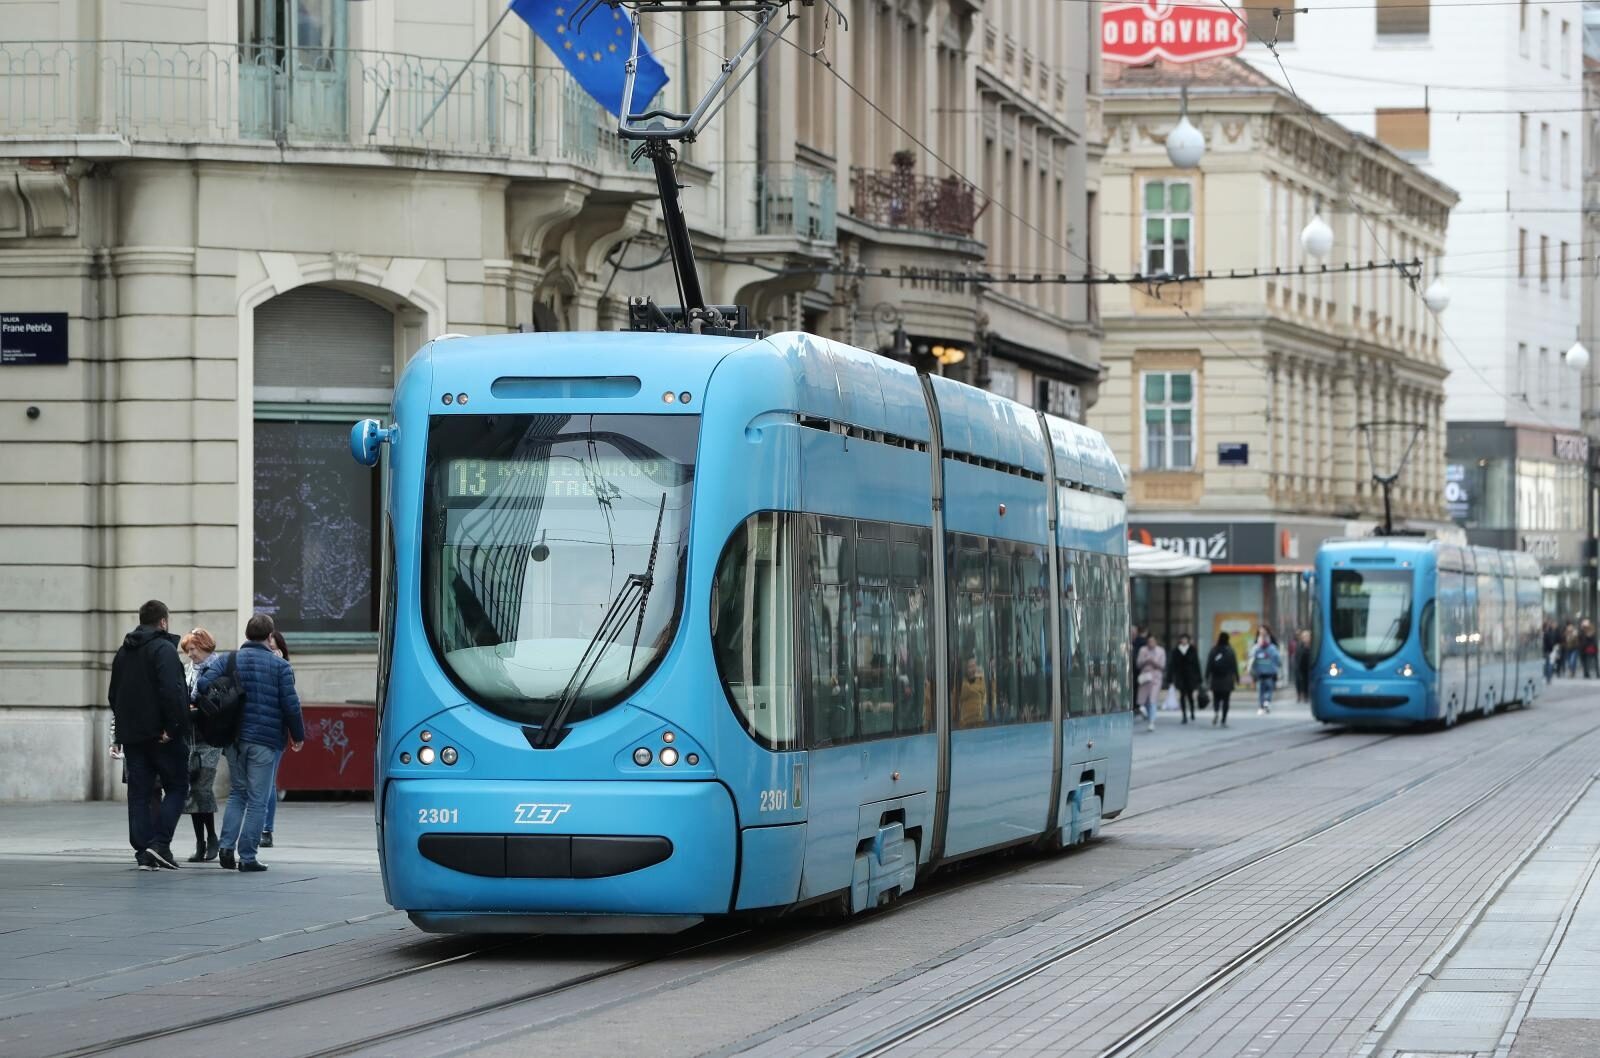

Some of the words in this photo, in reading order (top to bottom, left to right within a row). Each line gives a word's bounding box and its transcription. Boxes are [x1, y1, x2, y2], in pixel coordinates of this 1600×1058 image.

[1103, 18, 1230, 45] ODRAVKA
[2, 324, 25, 332] Frane
[25, 323, 53, 332] Petrića
[454, 461, 487, 495] 13
[760, 789, 788, 812] 2301
[418, 808, 459, 824] 2301
[514, 803, 572, 825] ZET
